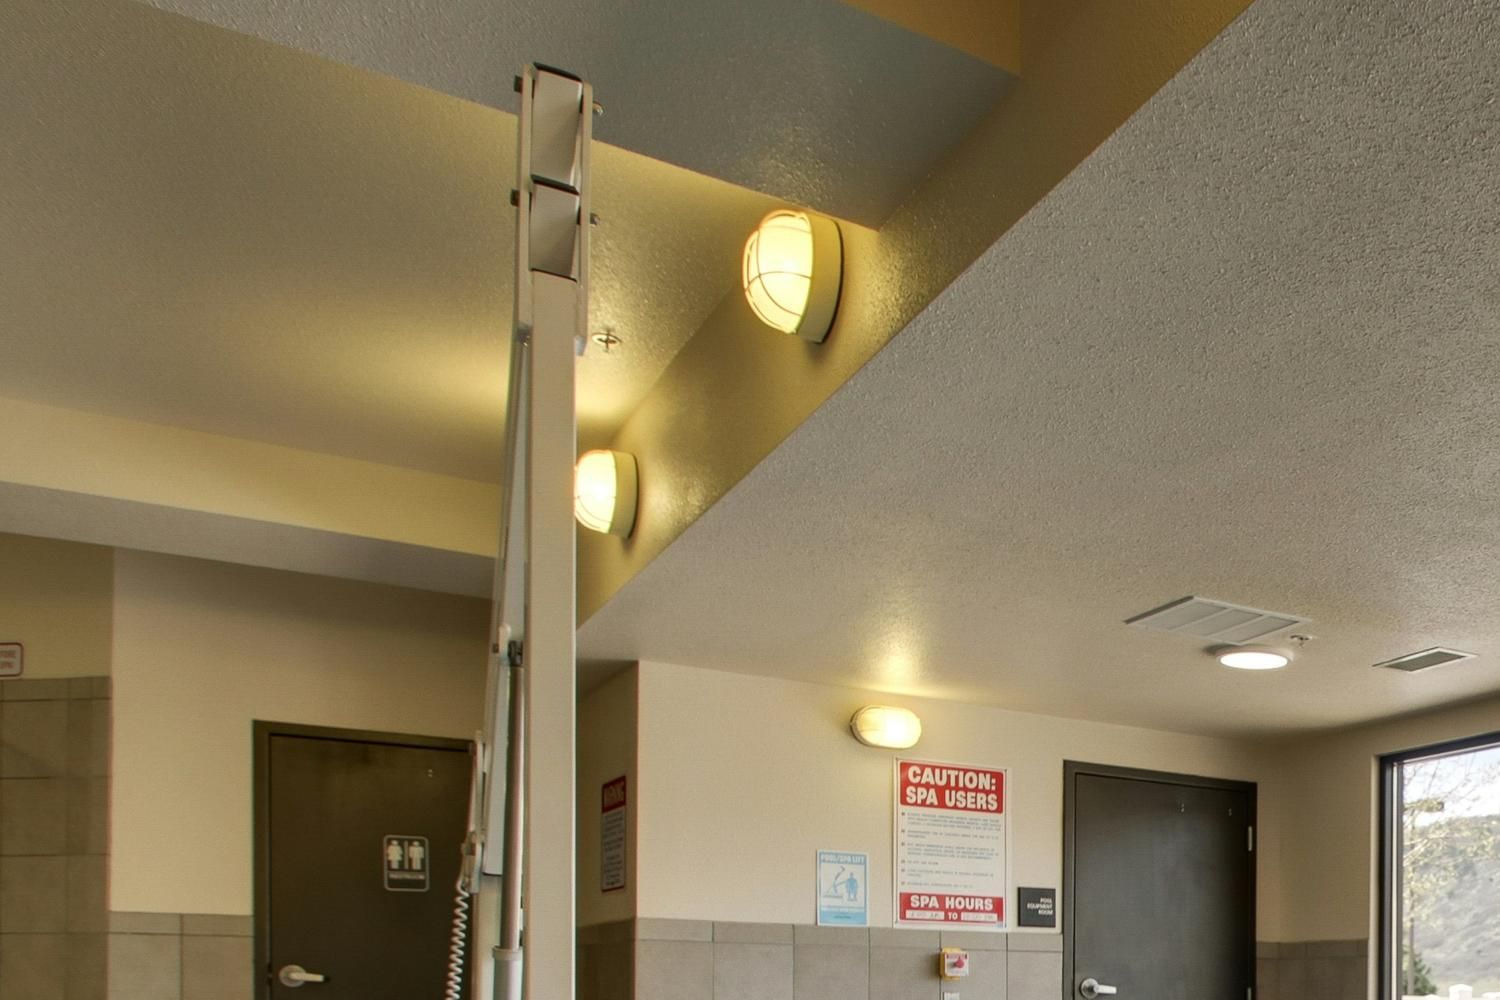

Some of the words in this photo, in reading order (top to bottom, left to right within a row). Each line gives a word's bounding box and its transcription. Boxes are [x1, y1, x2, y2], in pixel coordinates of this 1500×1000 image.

[908, 766, 996, 790] CAUTION:
[906, 787, 938, 806] SPA
[945, 791, 998, 811] USERS
[910, 895, 939, 908] SPA
[946, 897, 993, 911] HOURS
[947, 912, 958, 920] TO
